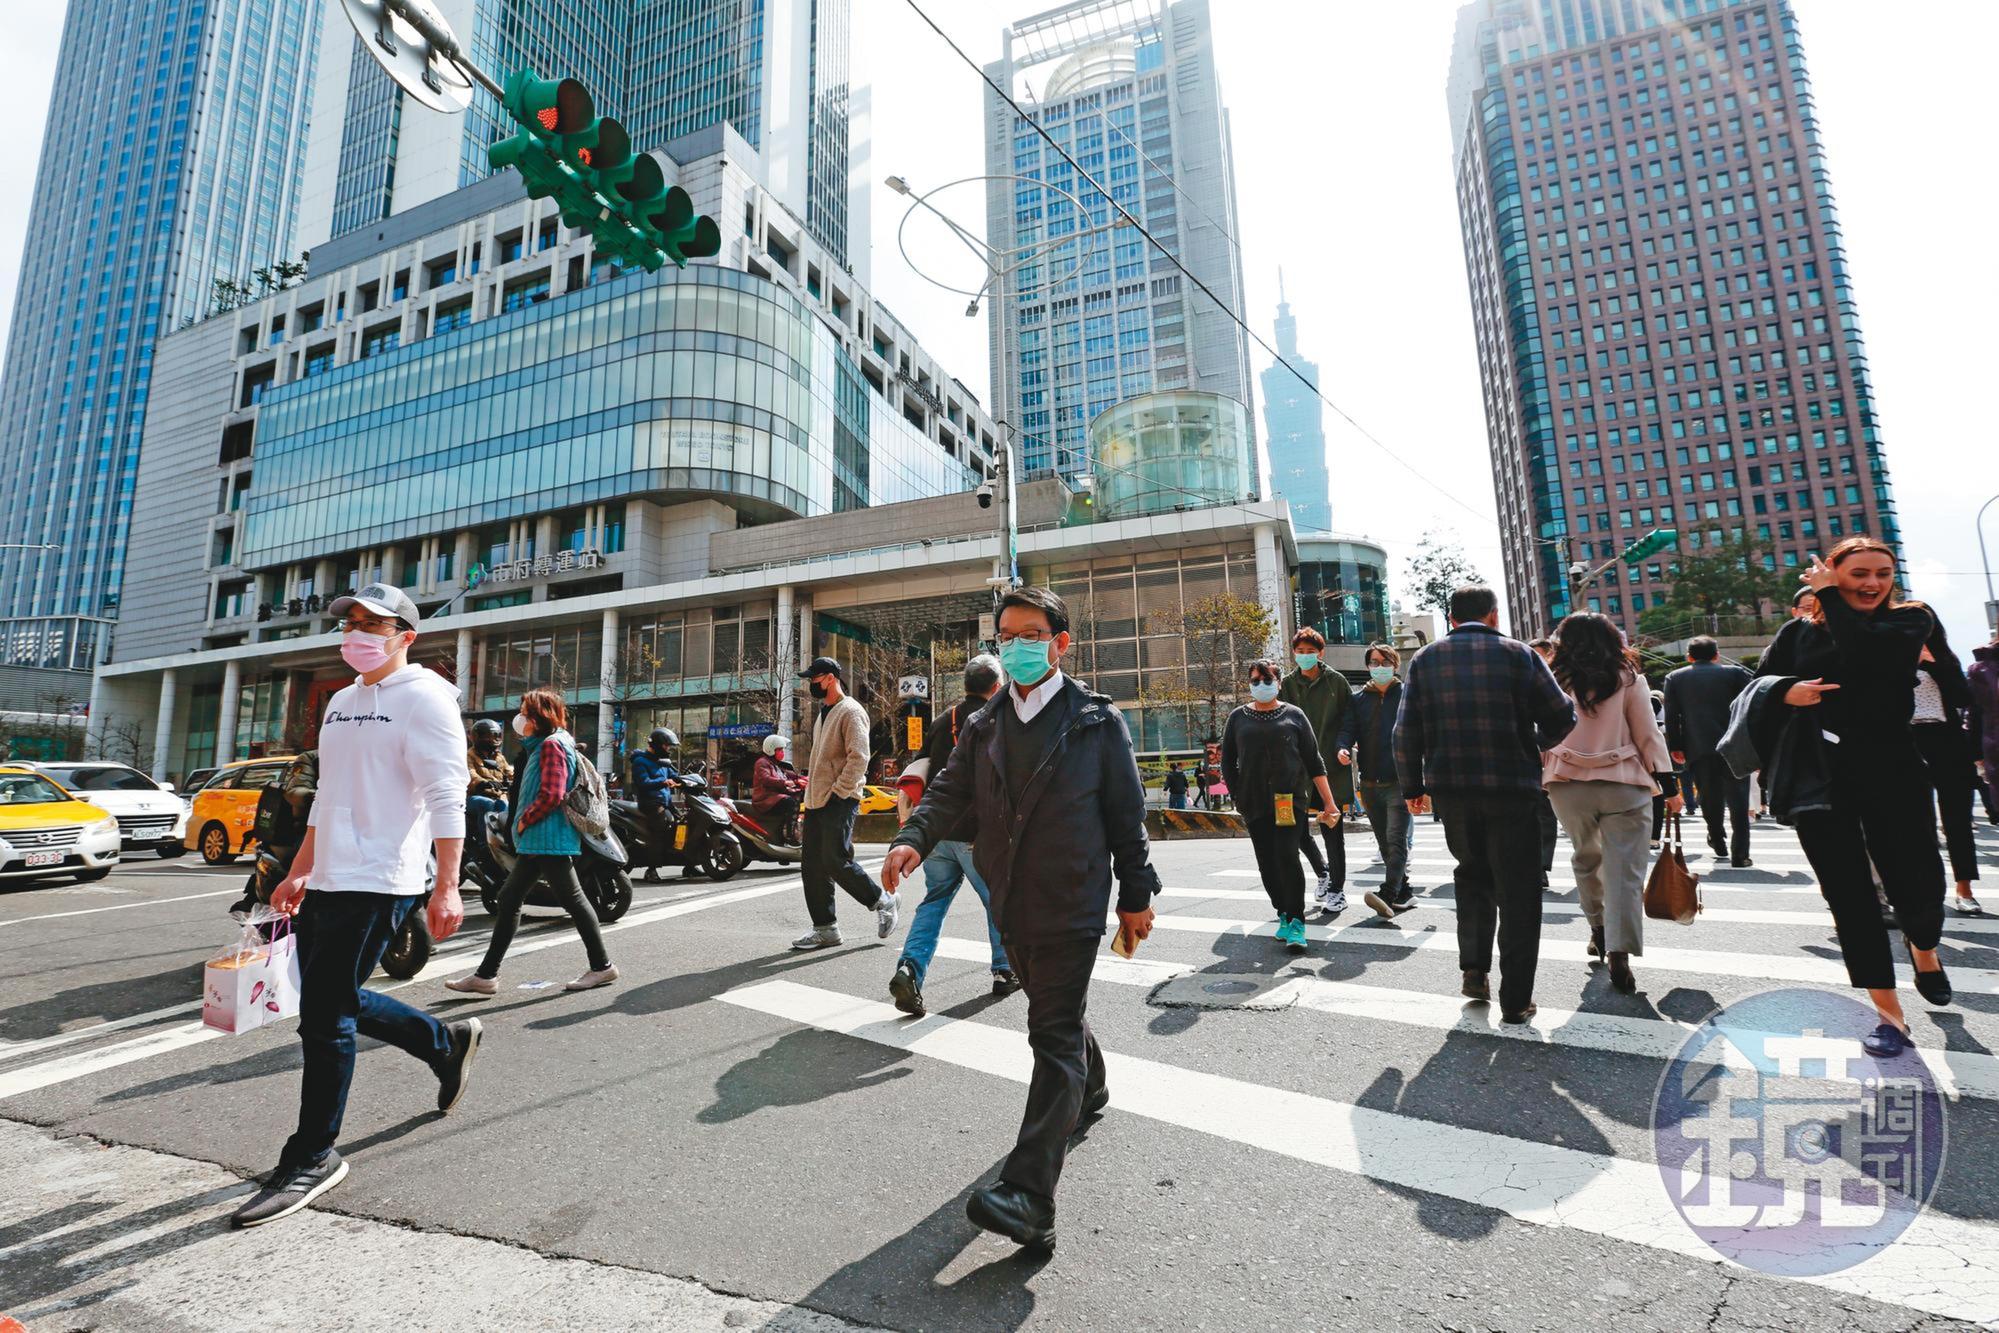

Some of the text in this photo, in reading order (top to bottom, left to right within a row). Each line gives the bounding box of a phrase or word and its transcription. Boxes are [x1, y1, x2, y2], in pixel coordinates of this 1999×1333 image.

[492, 548, 598, 582] 市府轉運站
[325, 711, 392, 726] Champion
